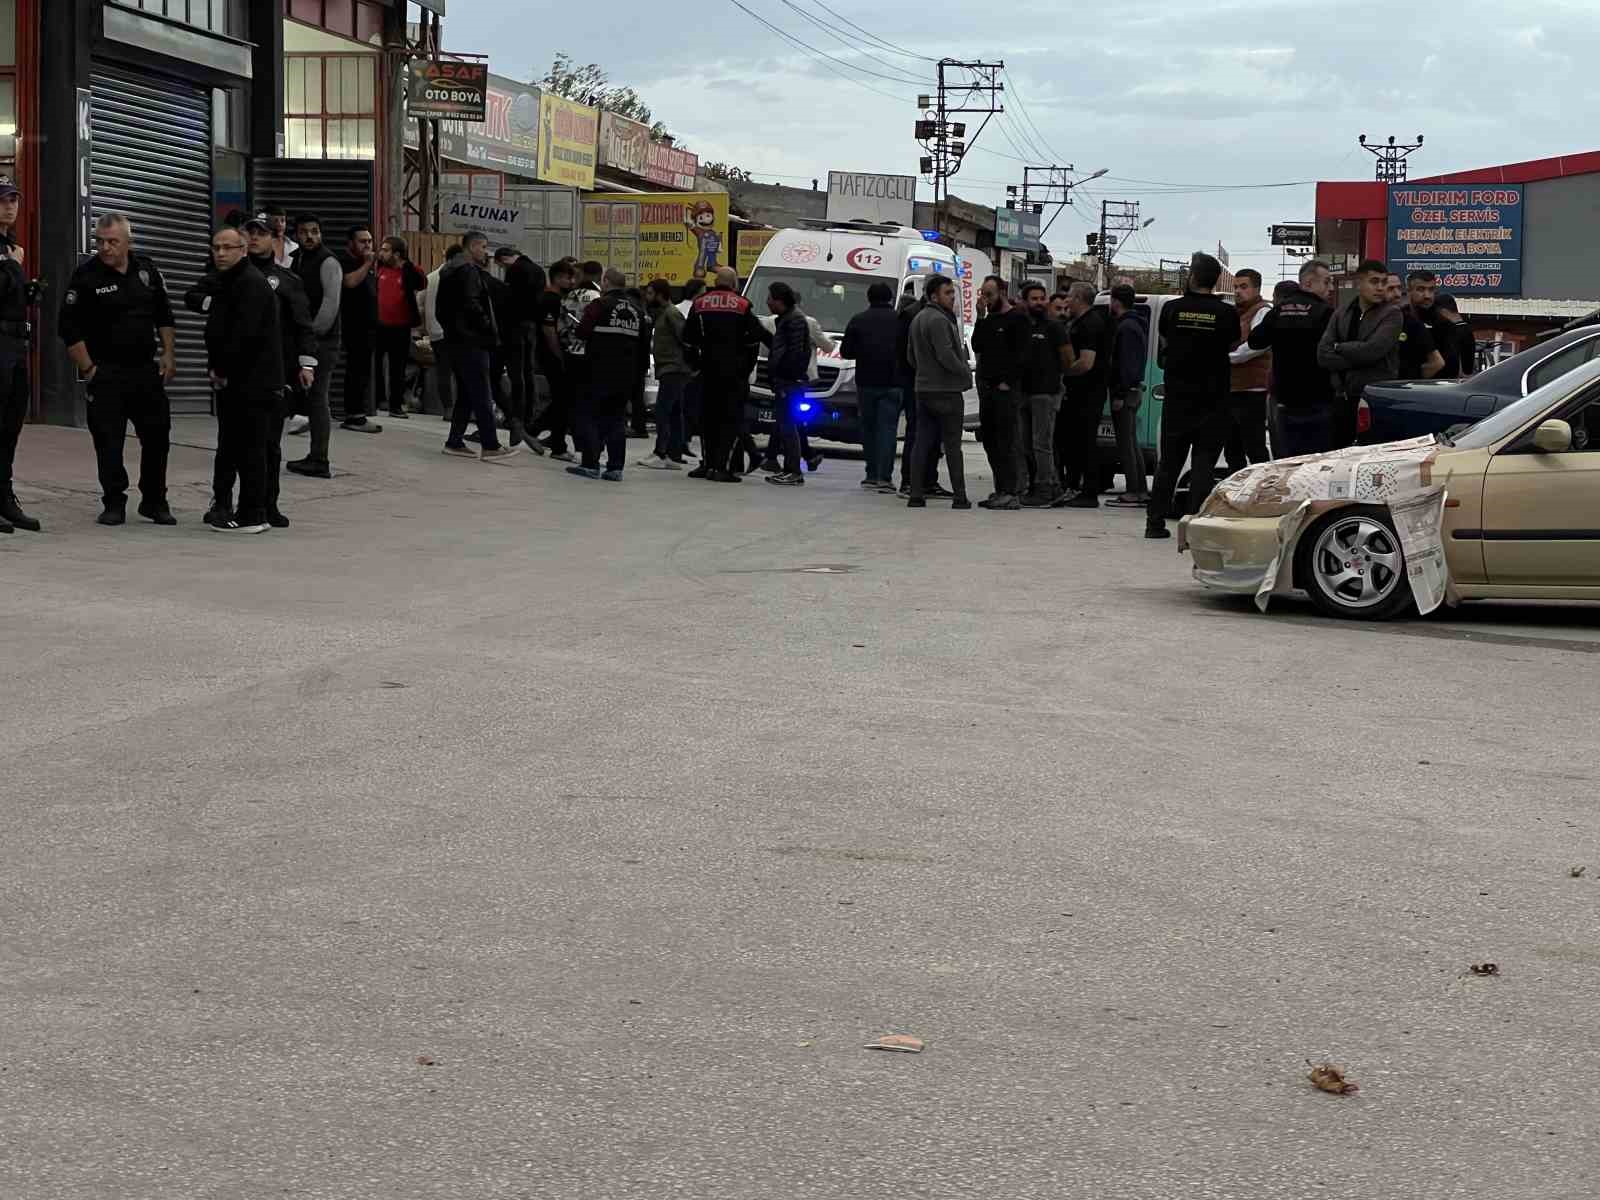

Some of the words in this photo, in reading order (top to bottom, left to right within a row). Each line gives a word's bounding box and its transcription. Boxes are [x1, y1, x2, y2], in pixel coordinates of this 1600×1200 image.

[426, 65, 483, 79] ASAF
[425, 89, 449, 100] OTO
[451, 91, 481, 103] BOYA
[1393, 190, 1467, 206] YILDIRIM
[1471, 190, 1520, 206] FORD
[450, 202, 519, 223] ALTUNAY
[1411, 207, 1448, 223] ÖZEL
[1450, 206, 1500, 223] SERVİS
[1397, 226, 1454, 241] MEKANİK
[1455, 226, 1513, 240] ELEKTRİK
[1407, 242, 1465, 255] KAPORTA
[855, 254, 882, 265] 112
